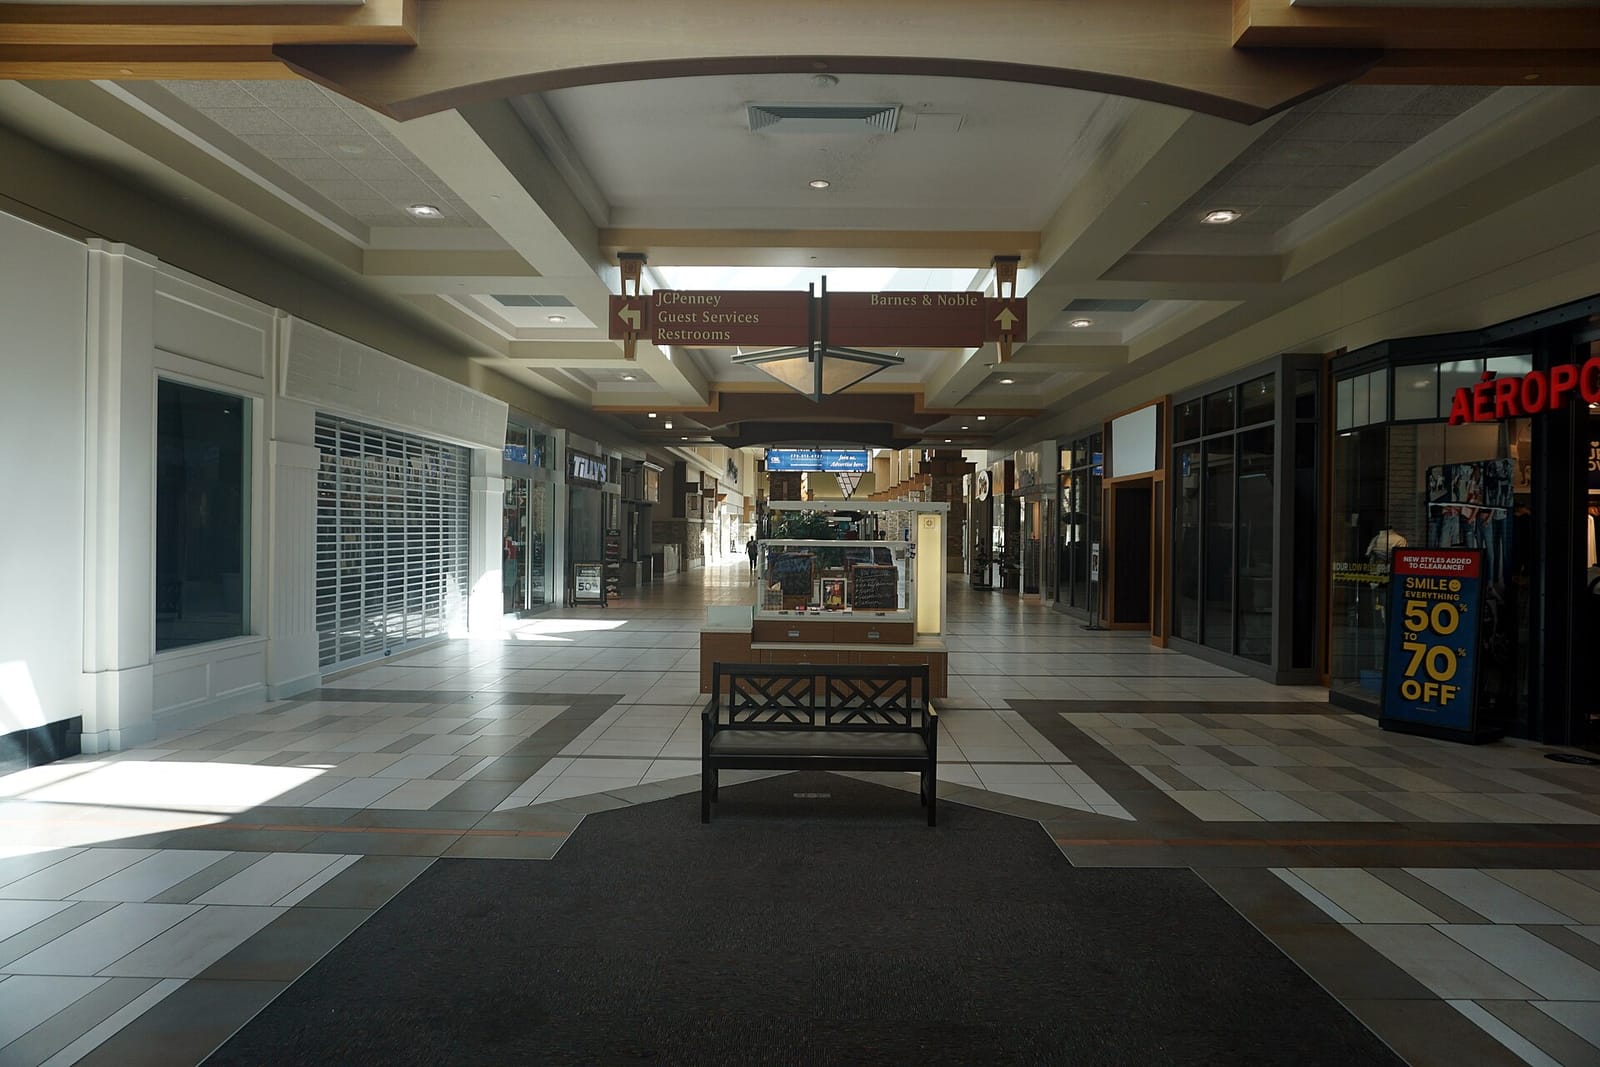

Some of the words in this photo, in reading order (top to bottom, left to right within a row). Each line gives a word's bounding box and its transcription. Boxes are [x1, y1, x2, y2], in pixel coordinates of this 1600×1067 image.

[656, 293, 721, 307] JCPenney
[871, 293, 917, 306] Barnes
[922, 294, 933, 306] &
[937, 294, 978, 306] Noble
[658, 311, 698, 324] Guest
[702, 311, 759, 324] Services
[657, 328, 731, 340] Restrooms
[1420, 563, 1465, 571] CLEARANCE!
[1406, 577, 1447, 591] SMILE
[1405, 591, 1461, 601] EVERYTHING
[1404, 632, 1417, 641] TO
